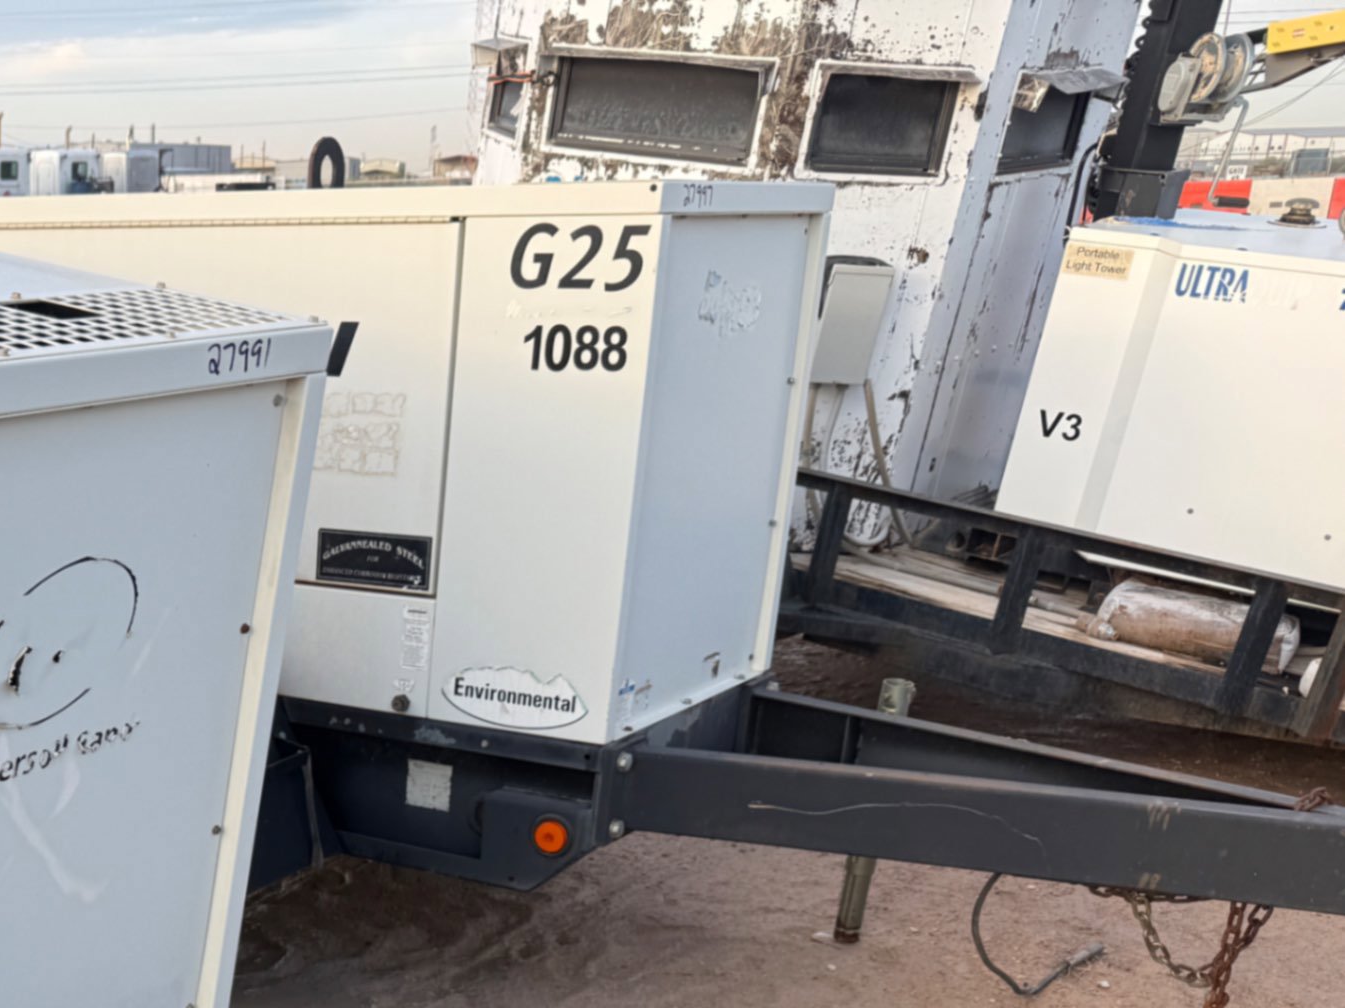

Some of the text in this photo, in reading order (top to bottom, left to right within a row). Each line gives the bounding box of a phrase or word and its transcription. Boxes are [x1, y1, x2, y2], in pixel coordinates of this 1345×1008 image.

[510, 222, 652, 292] G25
[1065, 260, 1127, 275] Light Tower
[1076, 246, 1121, 260] Portable
[1175, 263, 1250, 303] ULTRA
[208, 338, 271, 376] 27991
[523, 323, 628, 372] 1088
[1040, 409, 1082, 441] V3
[454, 676, 576, 713] Environmental
